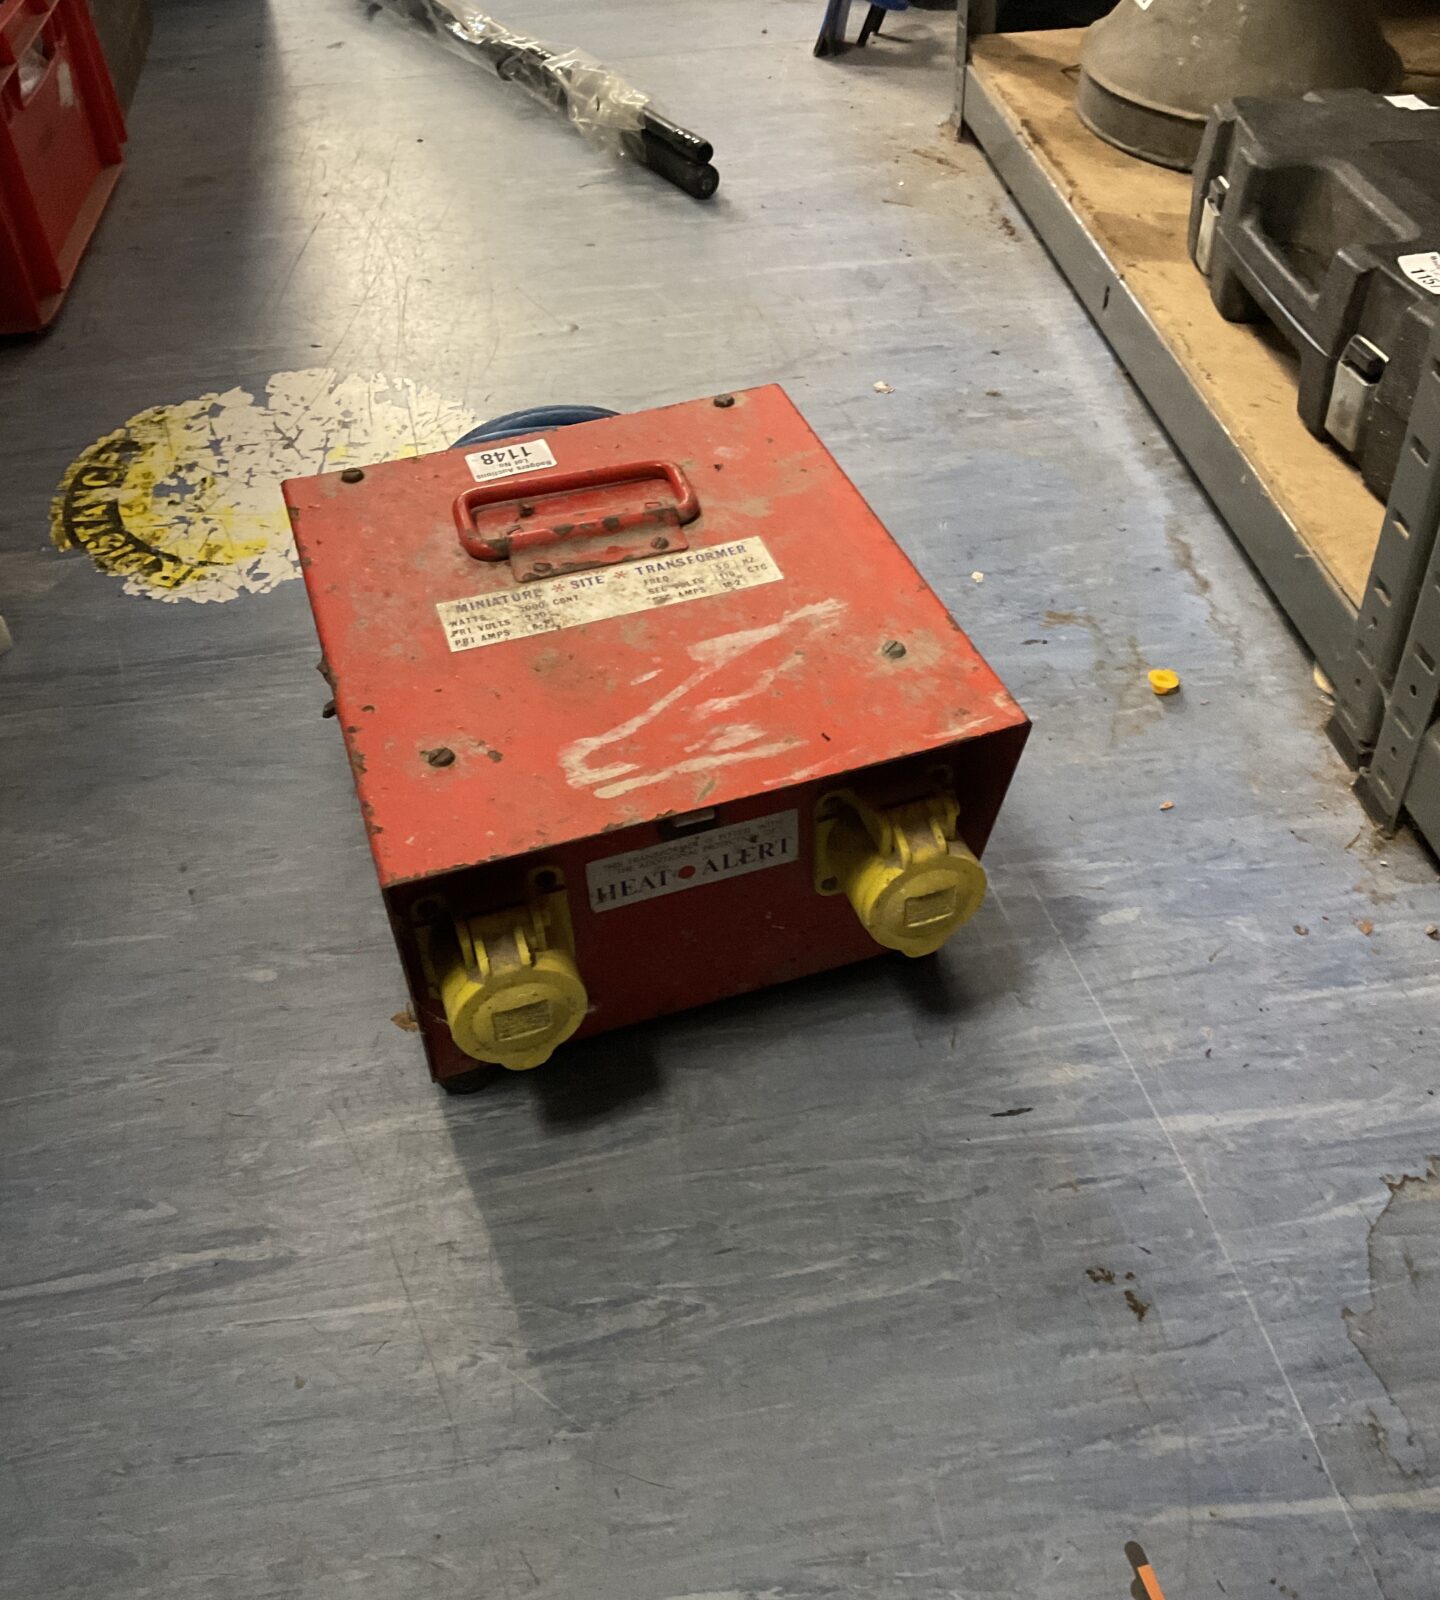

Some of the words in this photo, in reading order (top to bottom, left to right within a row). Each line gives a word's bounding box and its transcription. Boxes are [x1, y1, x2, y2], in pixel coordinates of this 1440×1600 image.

[480, 446, 532, 465] 1148
[516, 460, 552, 470] Badgers
[476, 468, 514, 479] Auctions
[455, 588, 544, 614] MINIATURE
[570, 575, 605, 590] SITE
[635, 544, 747, 576] TRANSFORMER
[678, 586, 707, 598] AMPS
[449, 613, 488, 628] WATTS
[477, 619, 511, 632] VOLTS
[481, 629, 511, 642] AMPS
[594, 869, 672, 904] HEAT
[702, 836, 793, 876] ALERT
